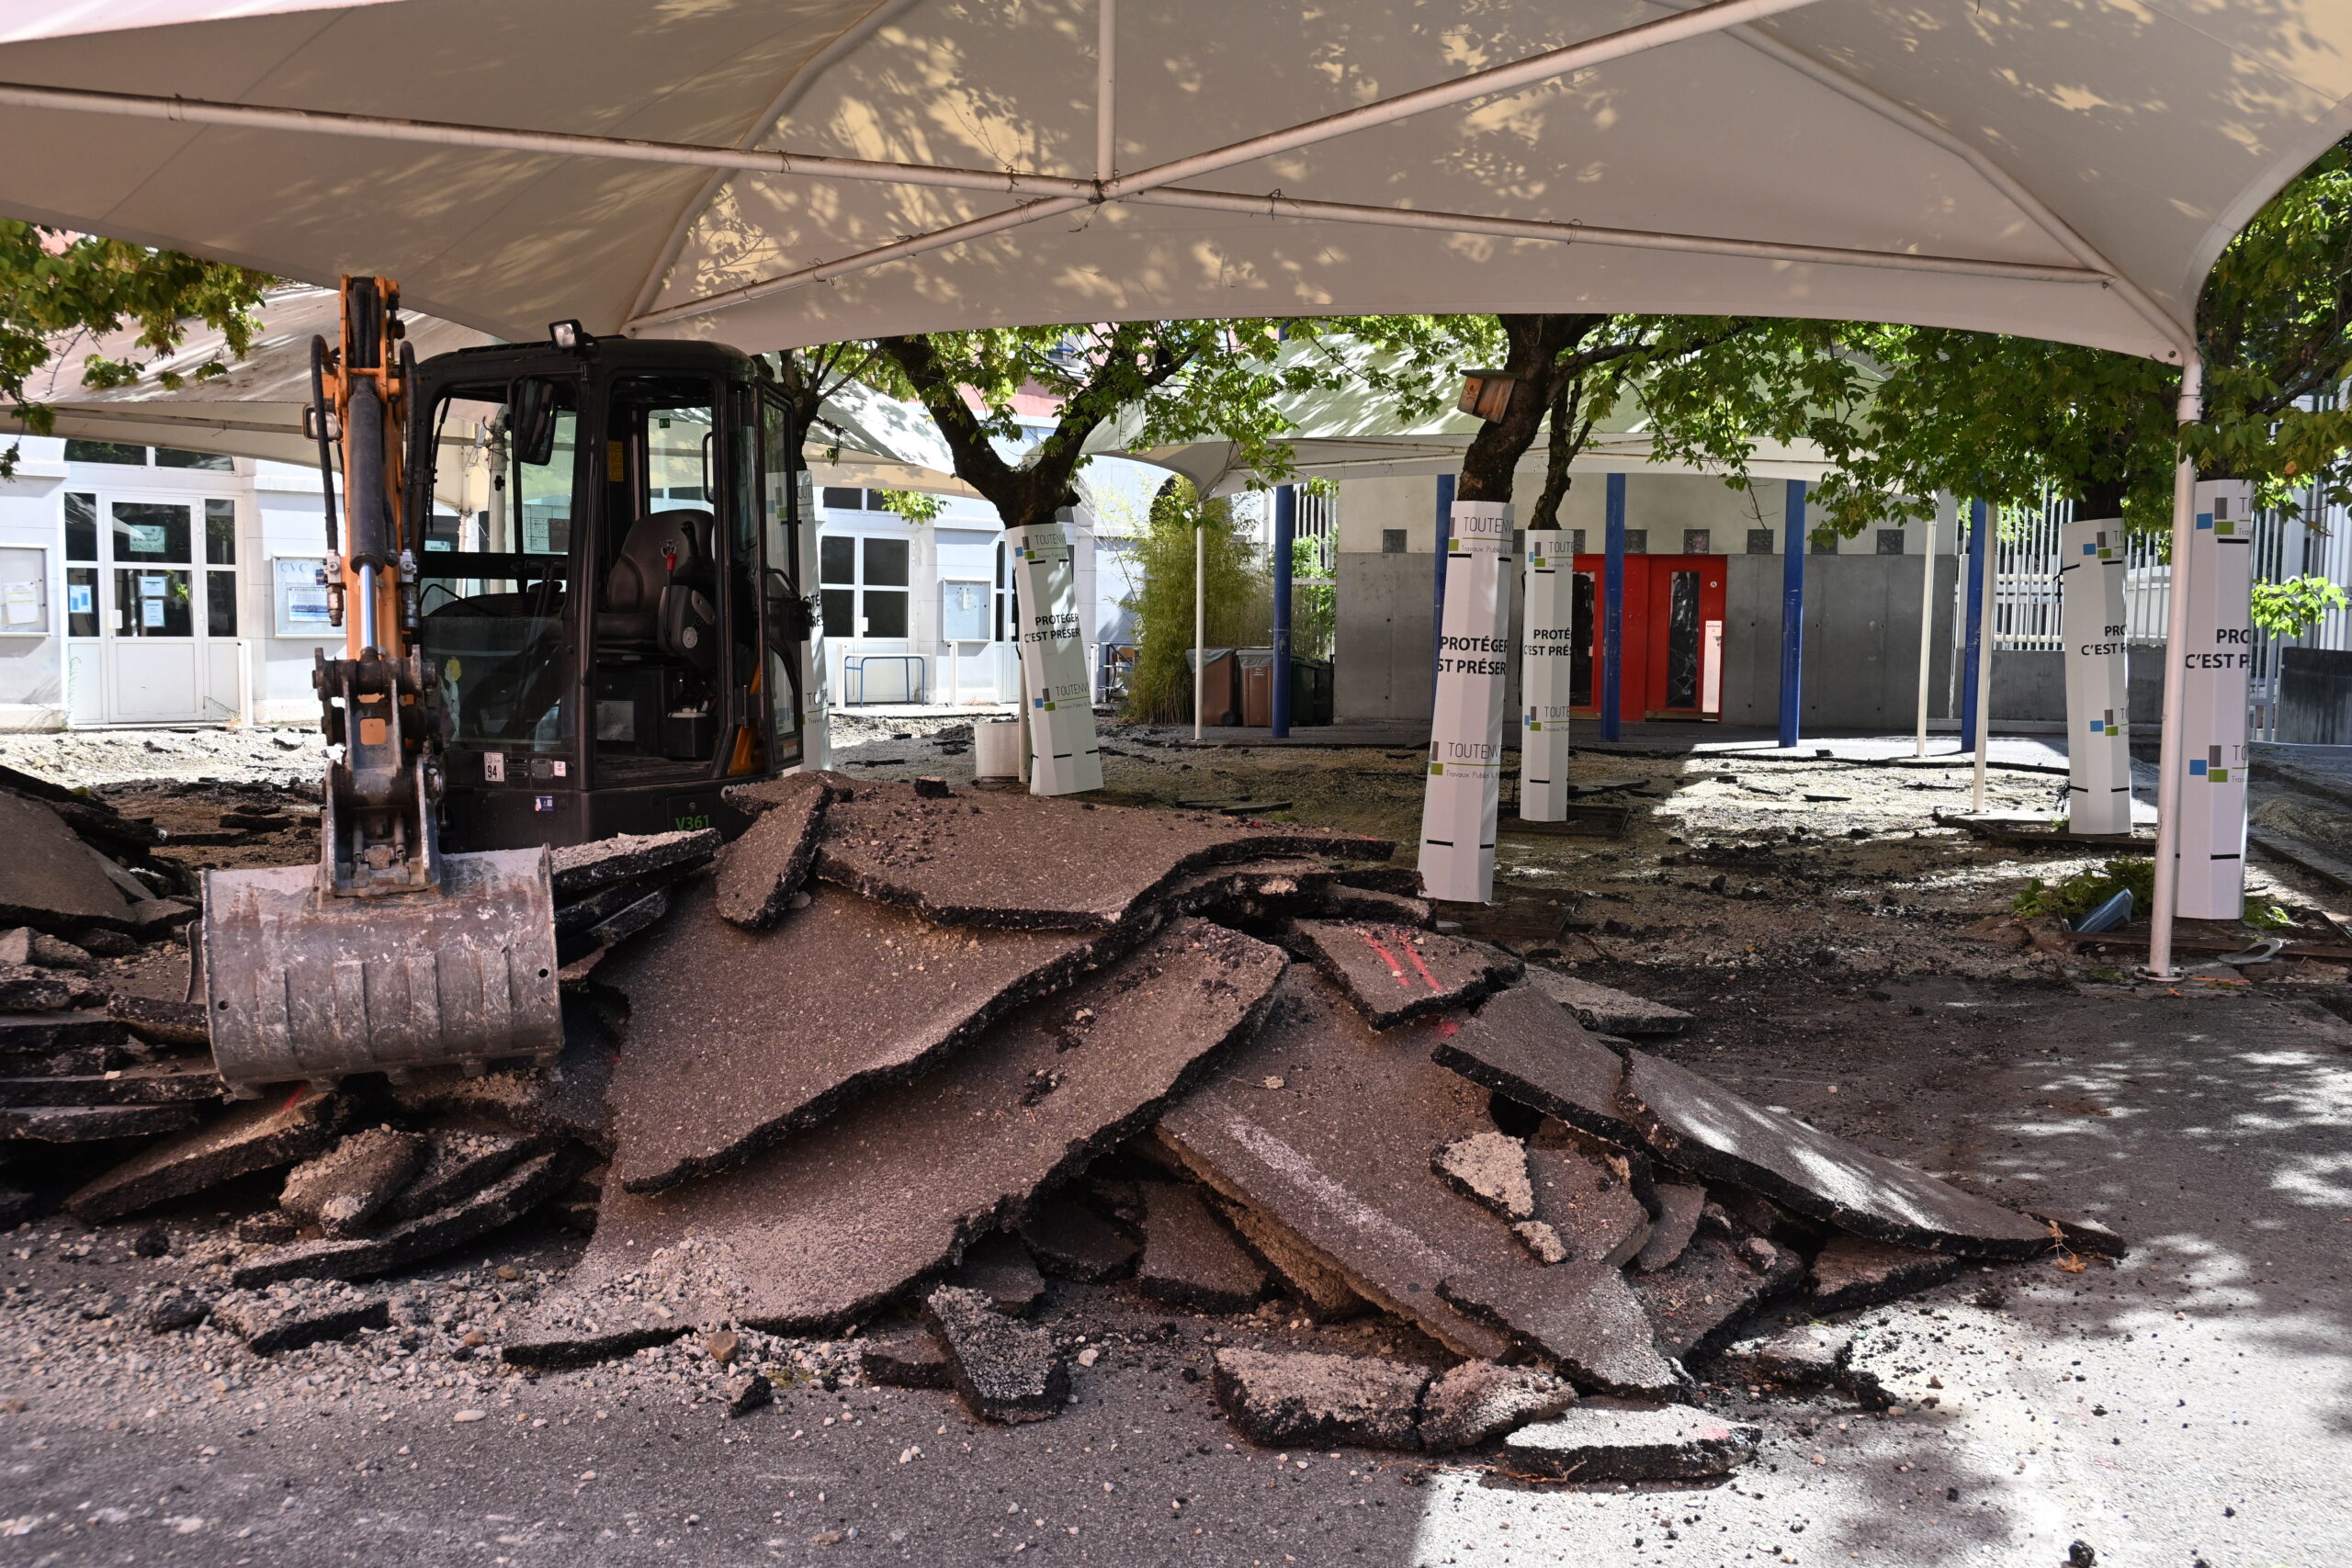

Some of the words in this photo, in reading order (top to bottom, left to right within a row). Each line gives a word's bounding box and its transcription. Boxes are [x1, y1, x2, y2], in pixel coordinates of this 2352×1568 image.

[2081, 644, 2117, 656] C'EST
[2186, 654, 2233, 669] C'EST
[487, 764, 497, 779] 94
